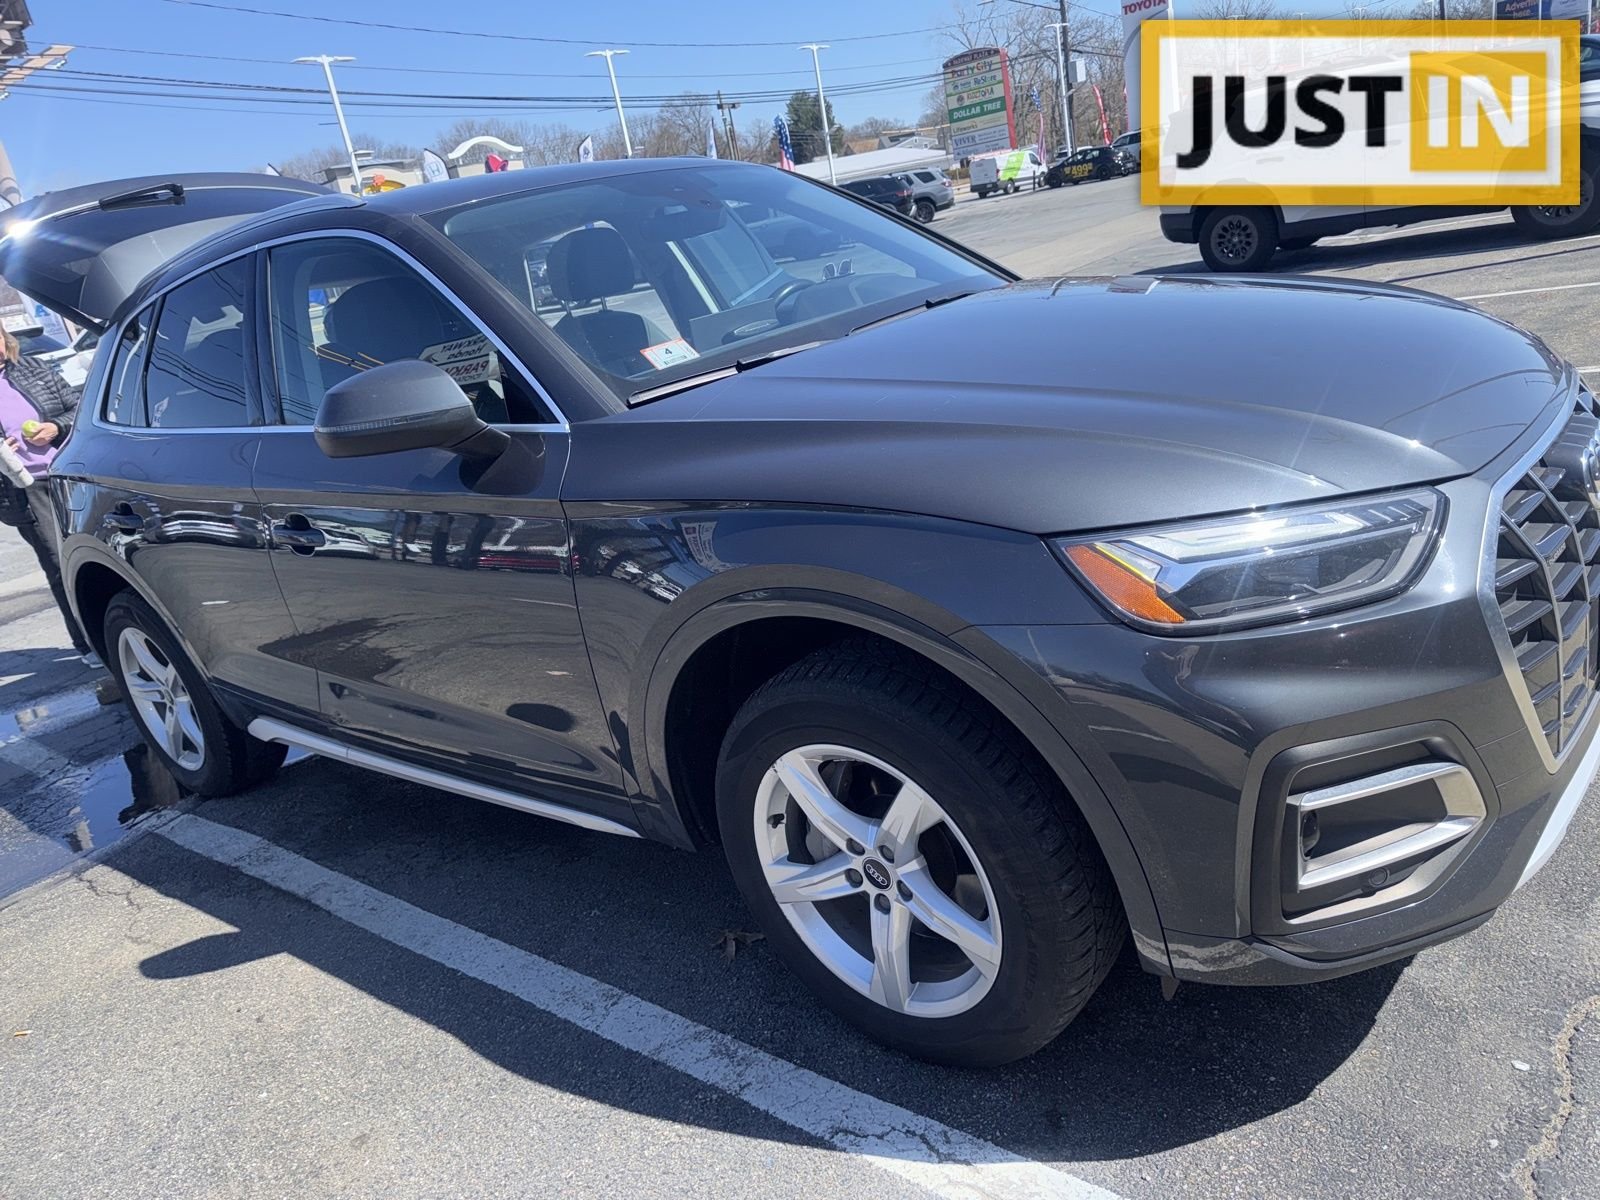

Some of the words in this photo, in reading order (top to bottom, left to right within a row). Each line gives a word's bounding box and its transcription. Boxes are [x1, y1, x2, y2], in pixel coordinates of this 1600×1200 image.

[1122, 0, 1167, 15] TOYOTA
[1505, 0, 1537, 12] Adverti
[953, 106, 981, 120] DOLLAR
[983, 101, 1002, 111] TREE
